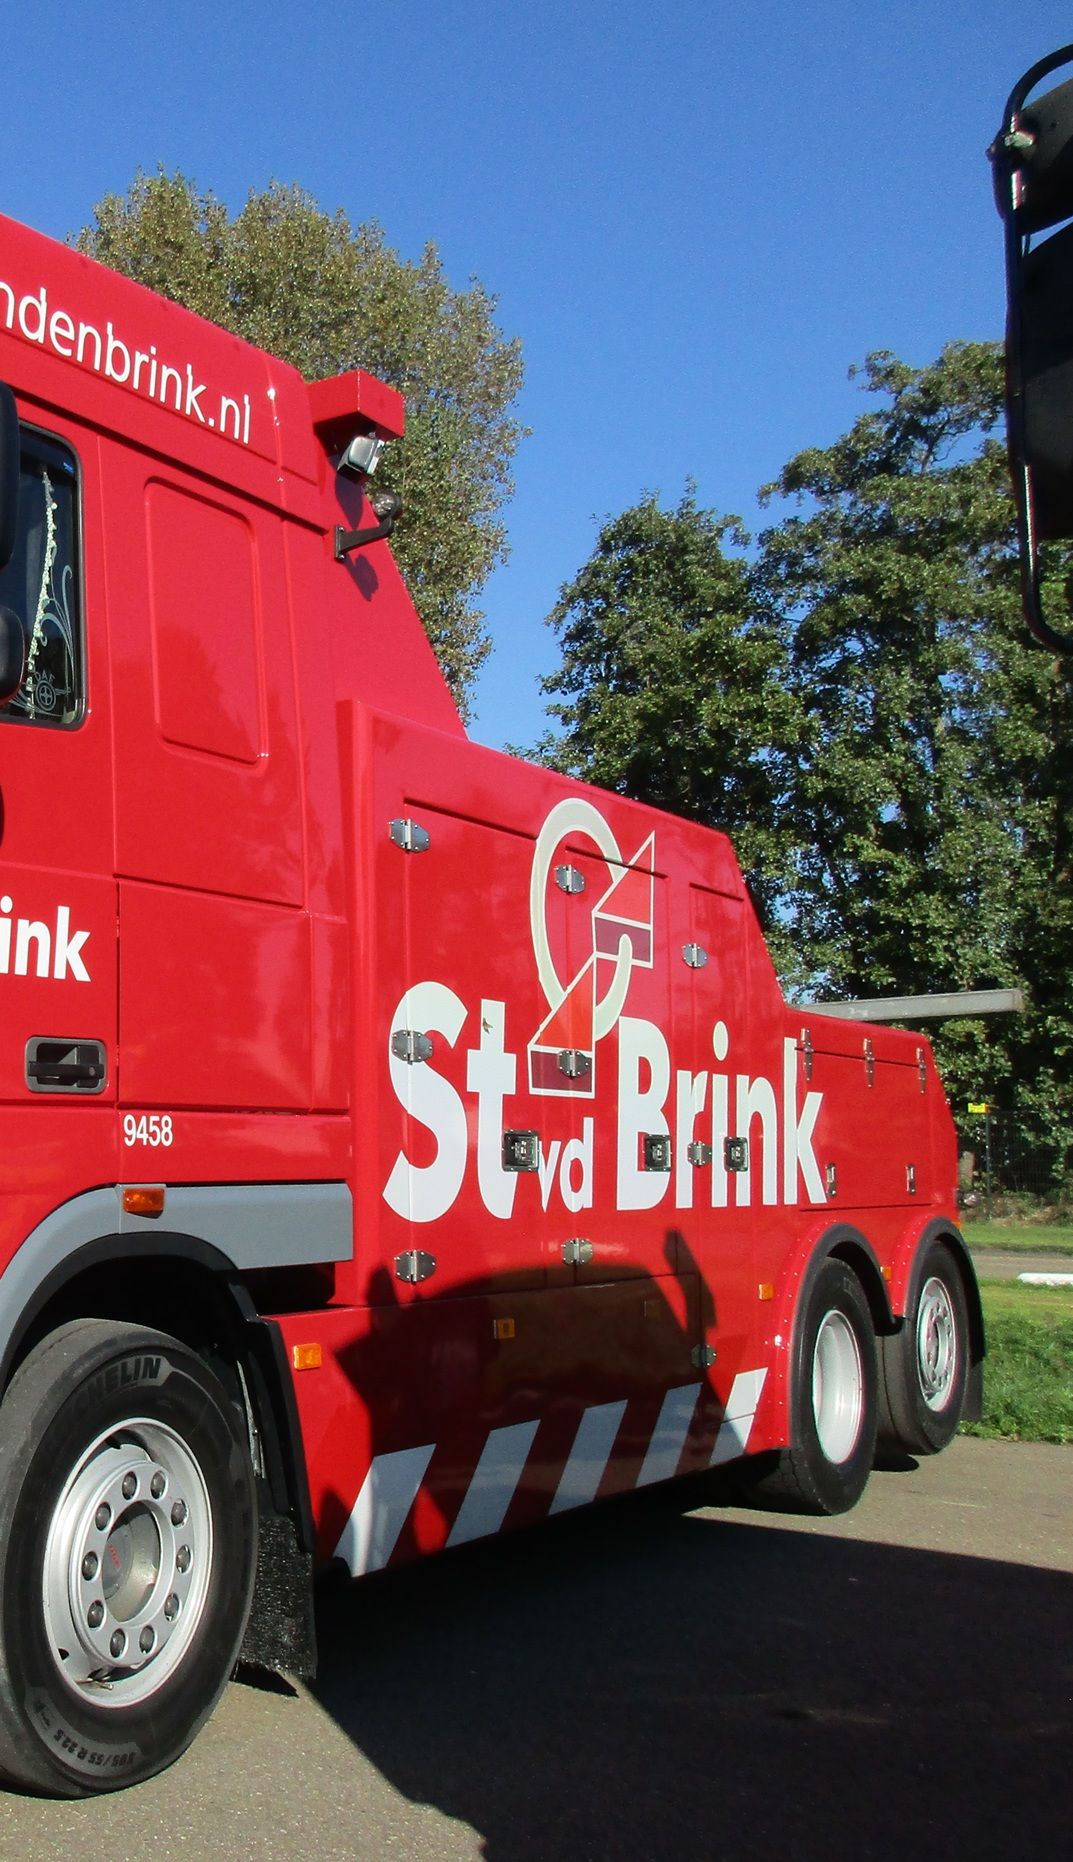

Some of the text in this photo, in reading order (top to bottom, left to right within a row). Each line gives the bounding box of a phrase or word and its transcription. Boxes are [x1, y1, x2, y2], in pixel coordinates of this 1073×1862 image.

[122, 1113, 174, 1147] 9458
[382, 981, 828, 1223] St vd Brink
